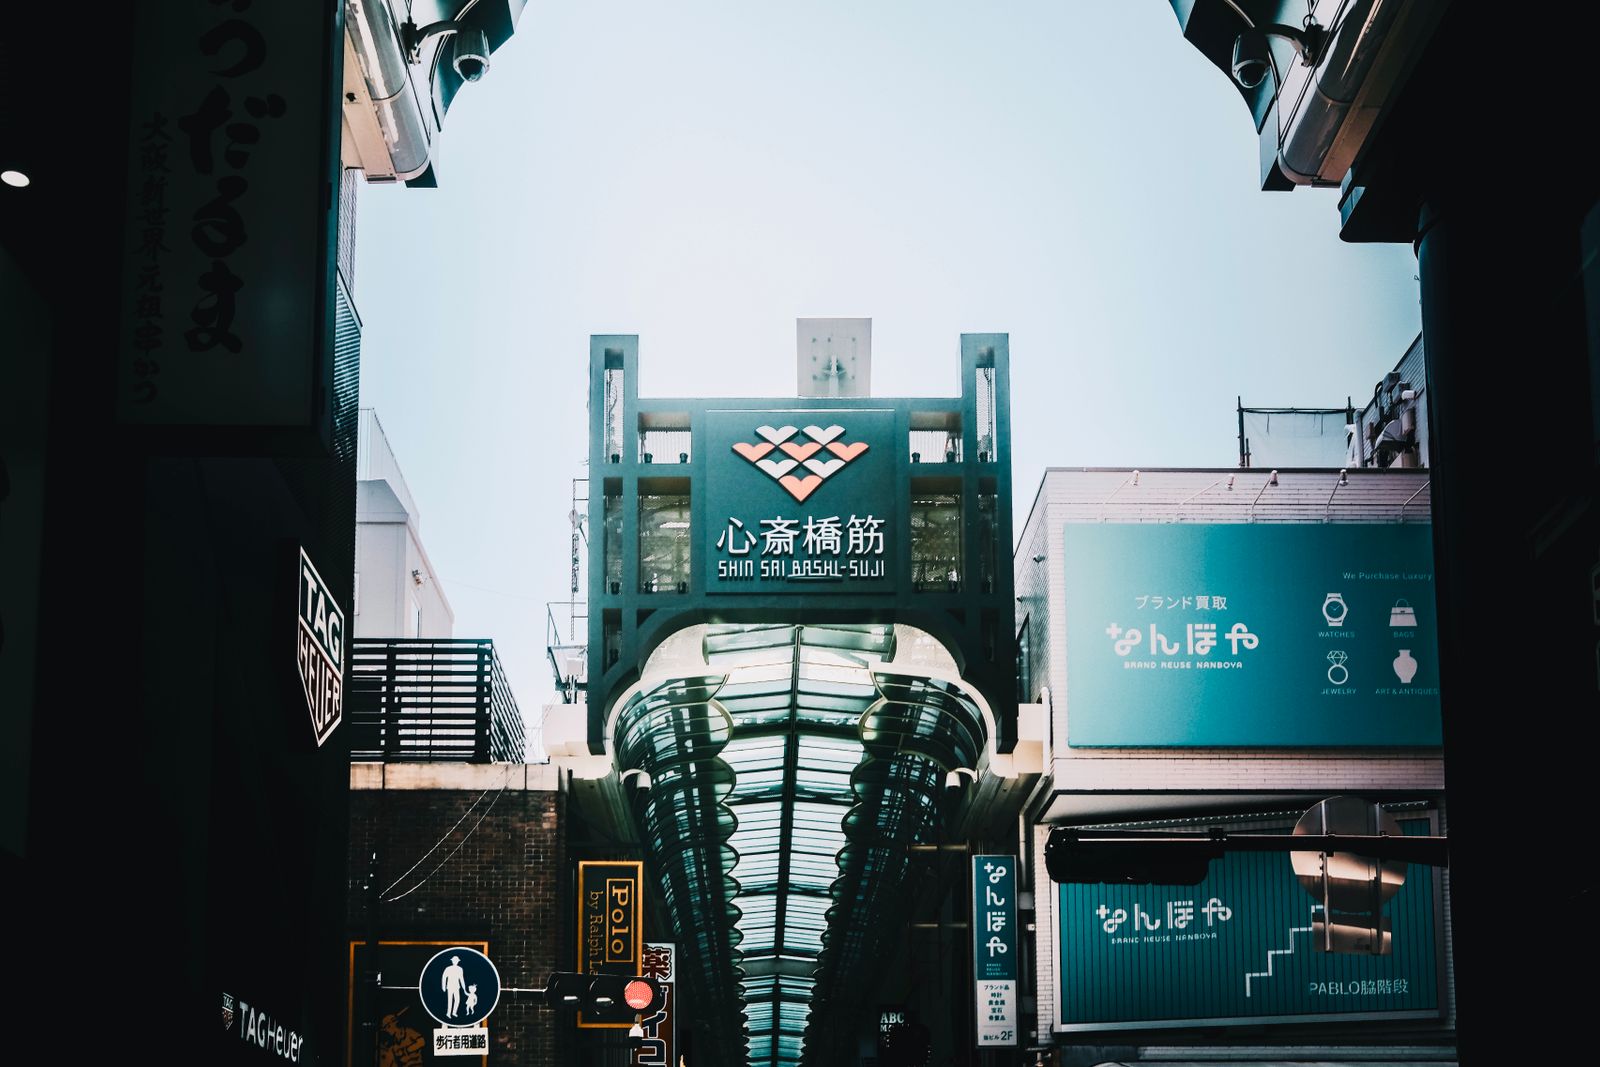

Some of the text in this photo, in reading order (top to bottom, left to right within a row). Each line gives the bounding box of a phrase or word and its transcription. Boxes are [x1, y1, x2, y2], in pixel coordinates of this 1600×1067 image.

[716, 514, 886, 556] 心斎橋筋
[718, 560, 754, 577] SHIN
[1342, 571, 1433, 582] We Purchase Luxury
[1134, 594, 1228, 611] ブランド買取
[302, 564, 341, 665] TAG
[1105, 622, 1260, 657] なんぼや
[1317, 631, 1356, 639] WATCHES
[1392, 631, 1415, 639] BAGS
[1124, 661, 1243, 670] BRAND REUSE NANBOYA
[299, 629, 341, 733] HEUER
[1320, 688, 1357, 696] JEWELRY
[586, 889, 604, 910] by
[983, 861, 1009, 957] なんぼや
[1095, 897, 1233, 934] なんぼや
[611, 884, 630, 955] Polo
[586, 913, 604, 958] Ralph
[879, 1011, 905, 1024] ABC
[435, 1034, 487, 1050] 歩行者用道路
[1000, 1030, 1013, 1041] 2F
